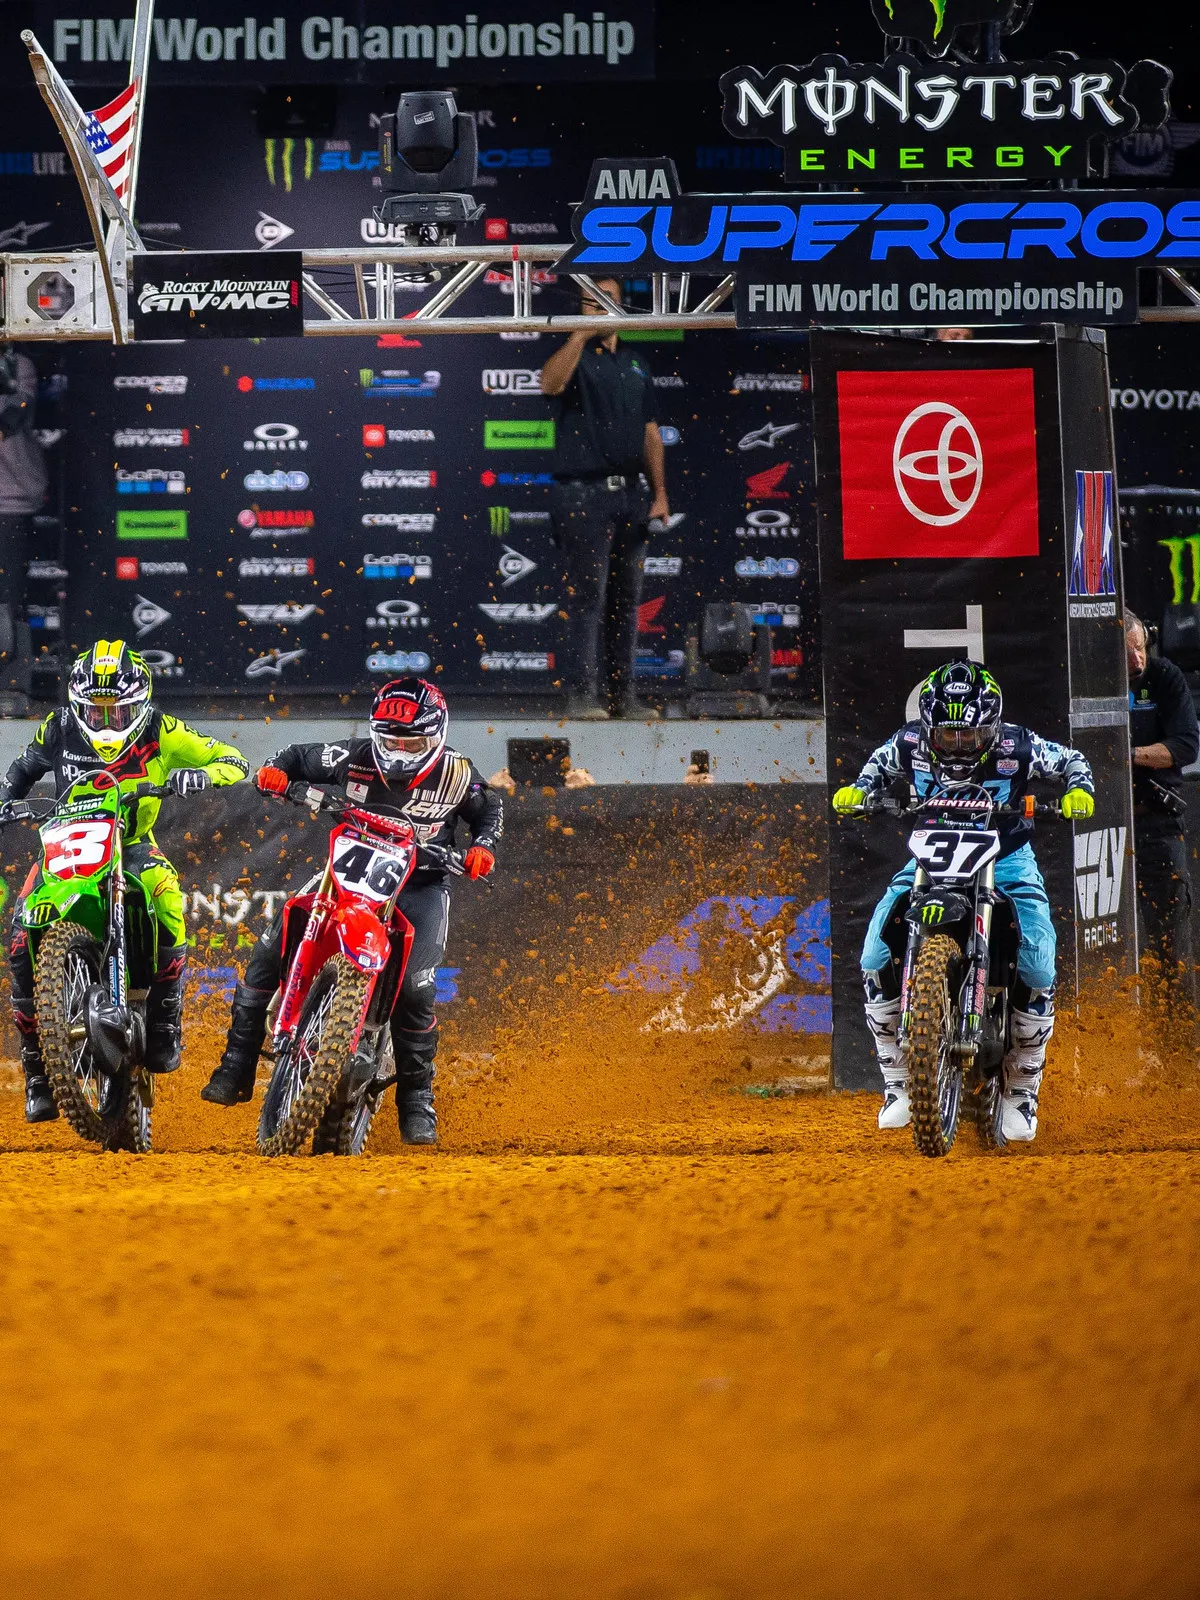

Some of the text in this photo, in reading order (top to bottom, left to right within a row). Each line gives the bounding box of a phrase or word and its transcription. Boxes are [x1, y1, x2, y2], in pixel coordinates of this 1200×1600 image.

[54, 14, 634, 67] FIM World Championship
[735, 65, 1123, 134] MONSTER
[801, 145, 1072, 170] ENERGY
[594, 169, 671, 199] AMA
[161, 280, 290, 293] ROCKY MOUNTAIN
[749, 280, 1123, 317] FIM World Championship
[652, 377, 685, 388] YOTA
[1110, 388, 1200, 410] TOYOTA
[387, 430, 435, 441] TOYOTA
[243, 441, 308, 451] OAKLEY
[116, 469, 185, 480] GoPro
[735, 527, 799, 537] OAKLEY
[363, 554, 432, 565] GoPro
[644, 557, 682, 566] PER
[746, 602, 800, 613] oPro
[366, 617, 430, 628] OAKLEY
[946, 683, 971, 693] Arai
[348, 763, 377, 772] DUNLOP
[928, 799, 994, 808] RENTHAL
[41, 821, 112, 874] 3
[919, 831, 997, 874] 37
[332, 844, 405, 896] 46
[118, 947, 127, 1007] DUNLOP
